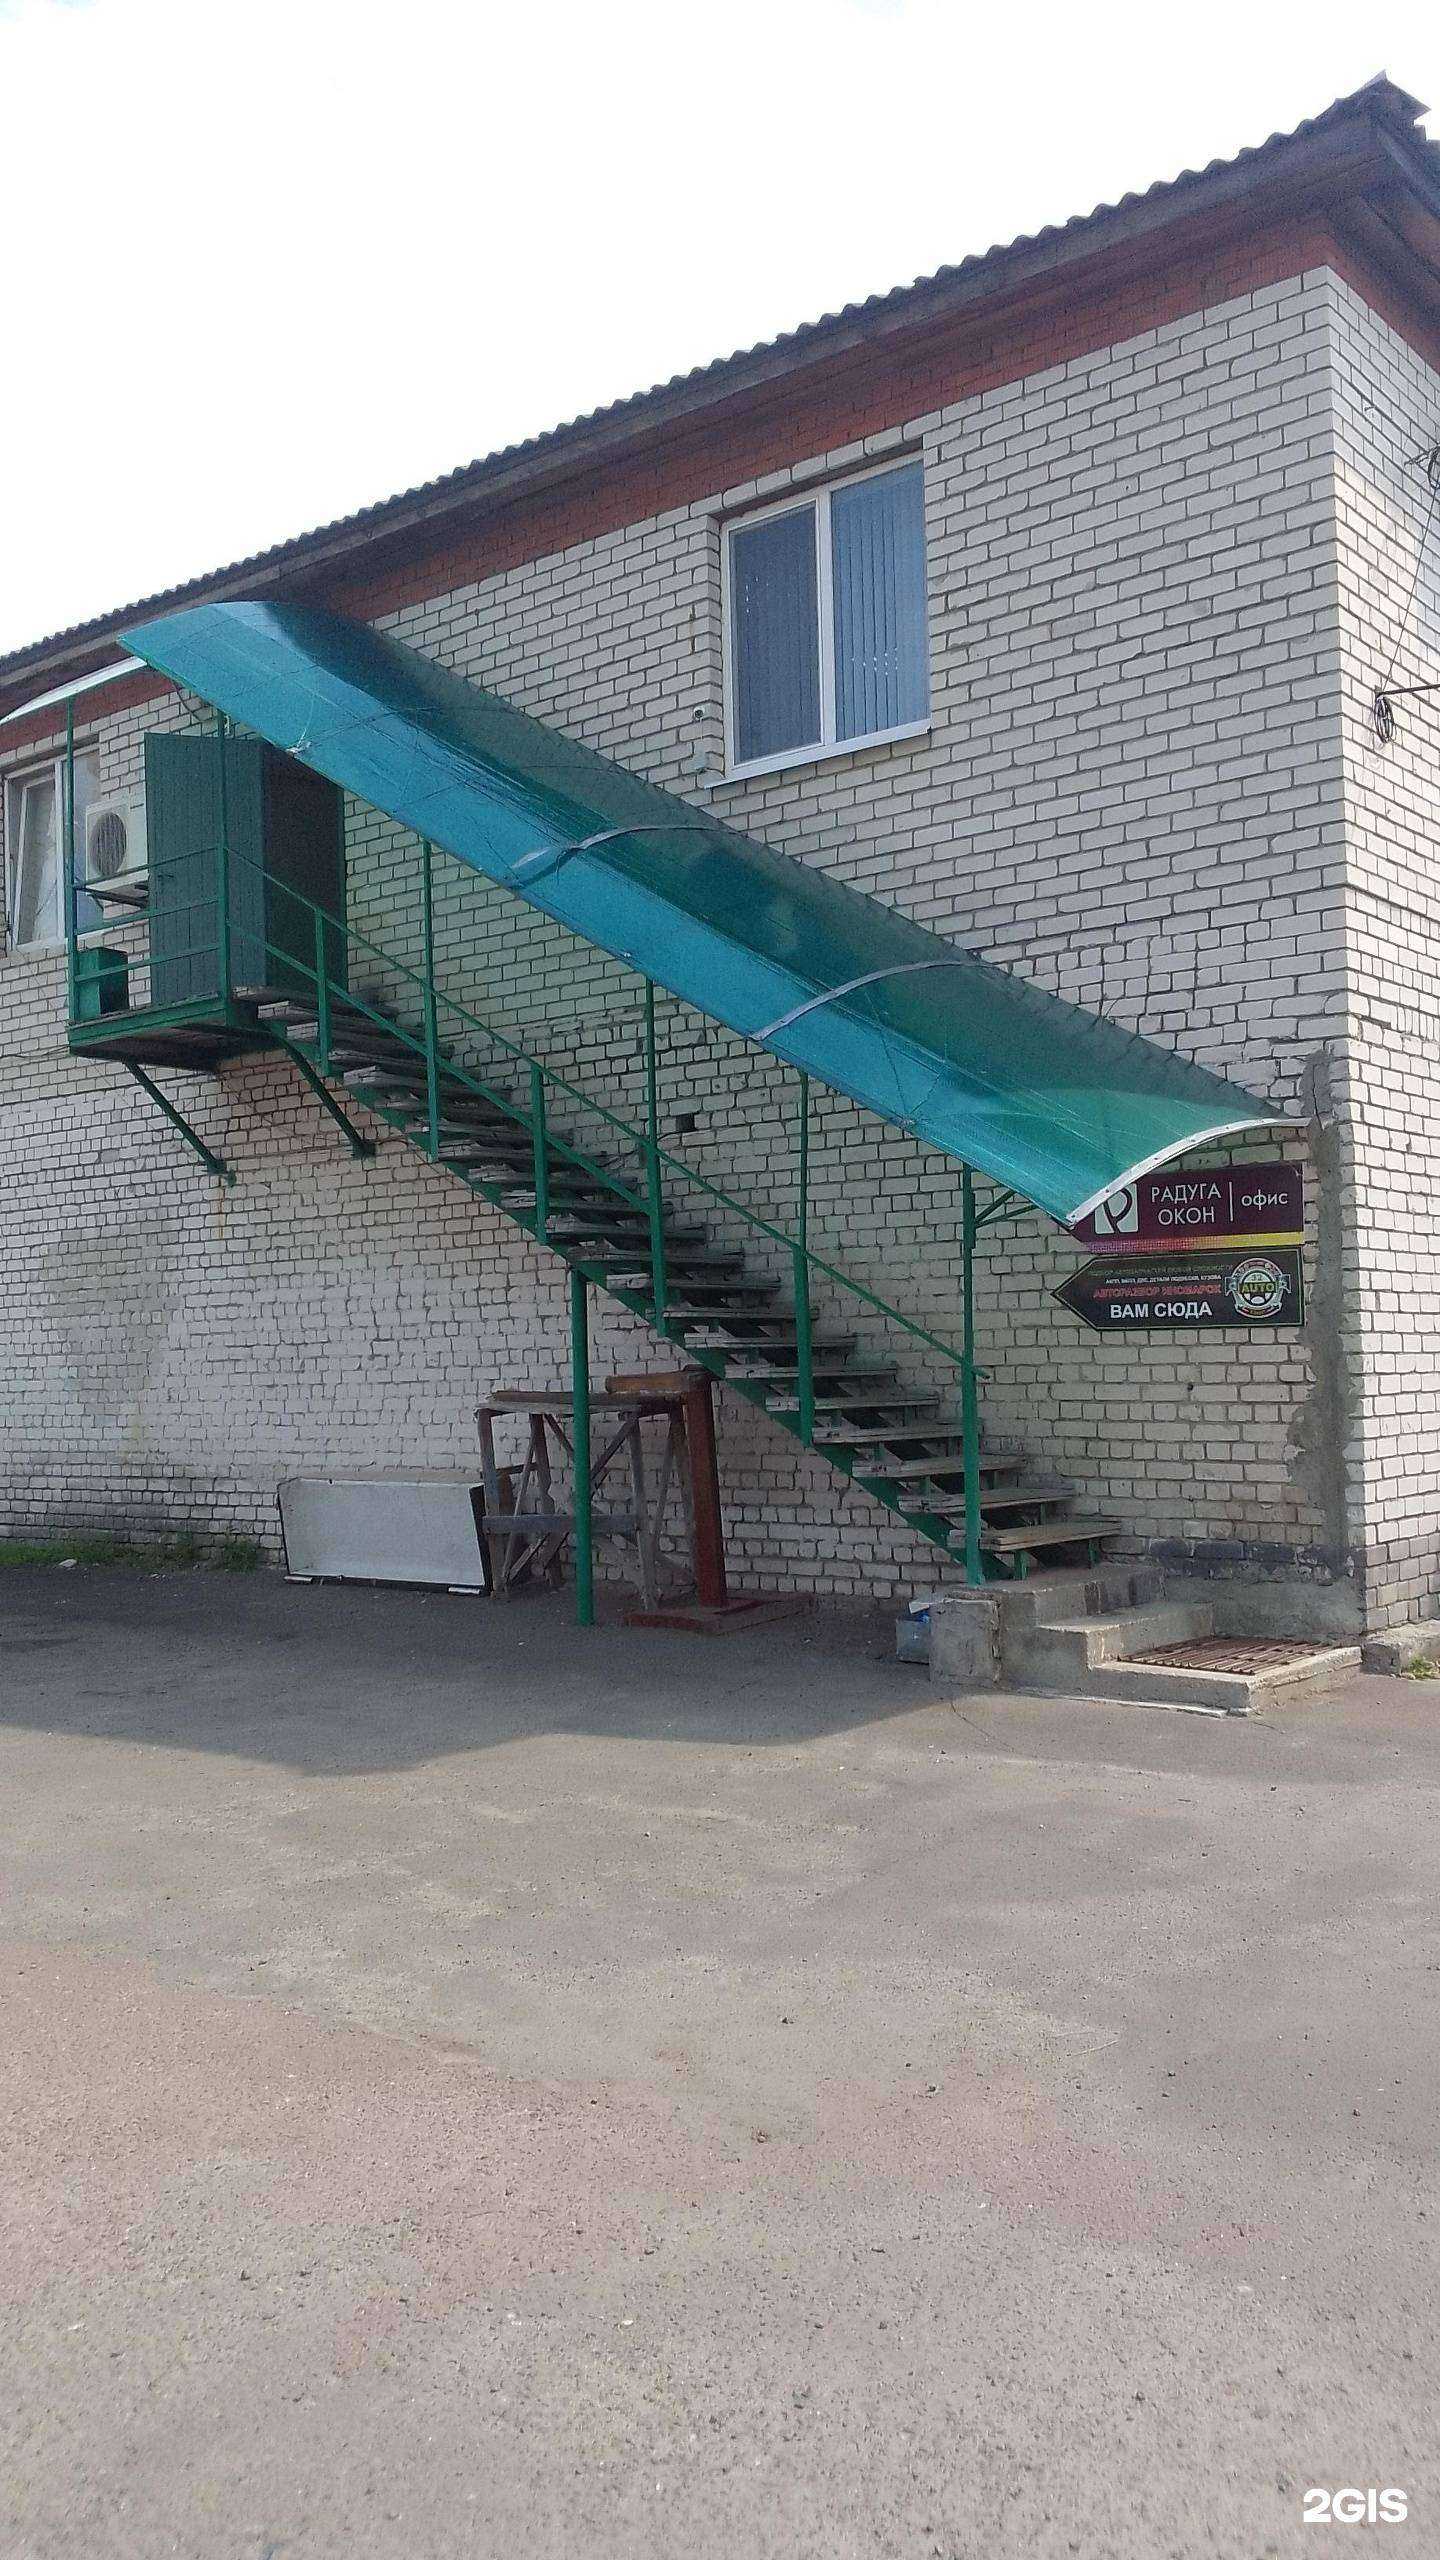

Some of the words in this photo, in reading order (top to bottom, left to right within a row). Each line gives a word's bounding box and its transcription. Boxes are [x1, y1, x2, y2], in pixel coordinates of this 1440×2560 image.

[1152, 1183, 1222, 1204] РАДУГА
[1158, 1206, 1215, 1226] ОКОН
[1242, 1282, 1275, 1294] AUTO
[1110, 1303, 1149, 1319] ВАМ
[1154, 1301, 1213, 1320] СЮДА
